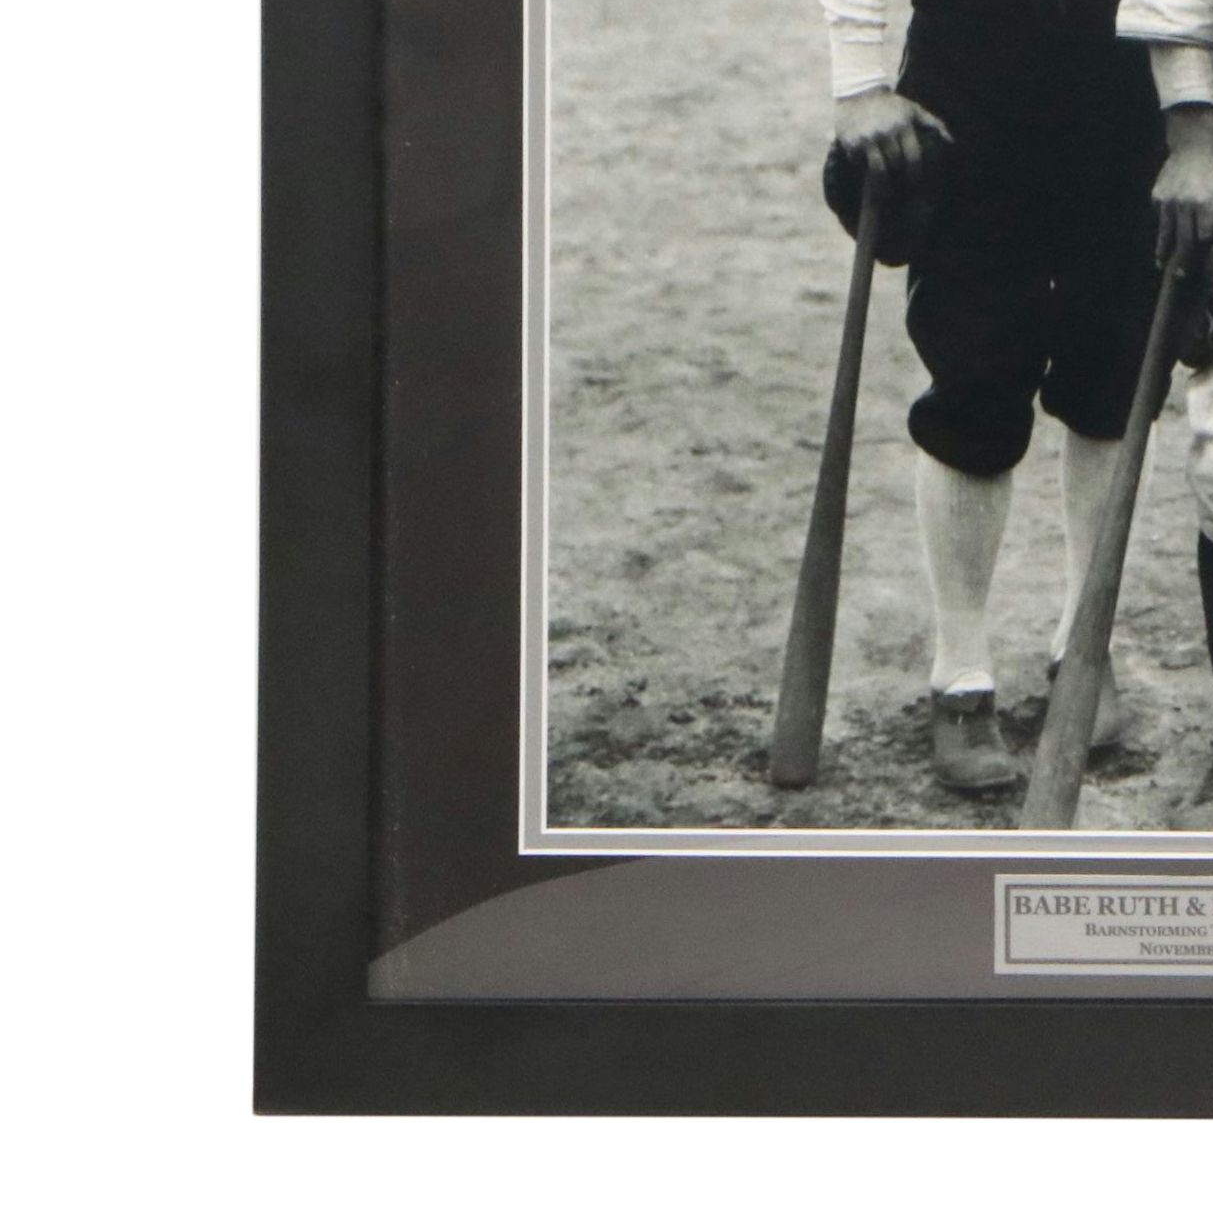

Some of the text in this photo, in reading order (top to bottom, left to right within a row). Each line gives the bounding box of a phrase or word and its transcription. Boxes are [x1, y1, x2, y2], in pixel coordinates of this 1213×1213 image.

[1014, 895, 1091, 916] BABE
[1099, 896, 1179, 917] RUTH
[1186, 896, 1206, 917] &
